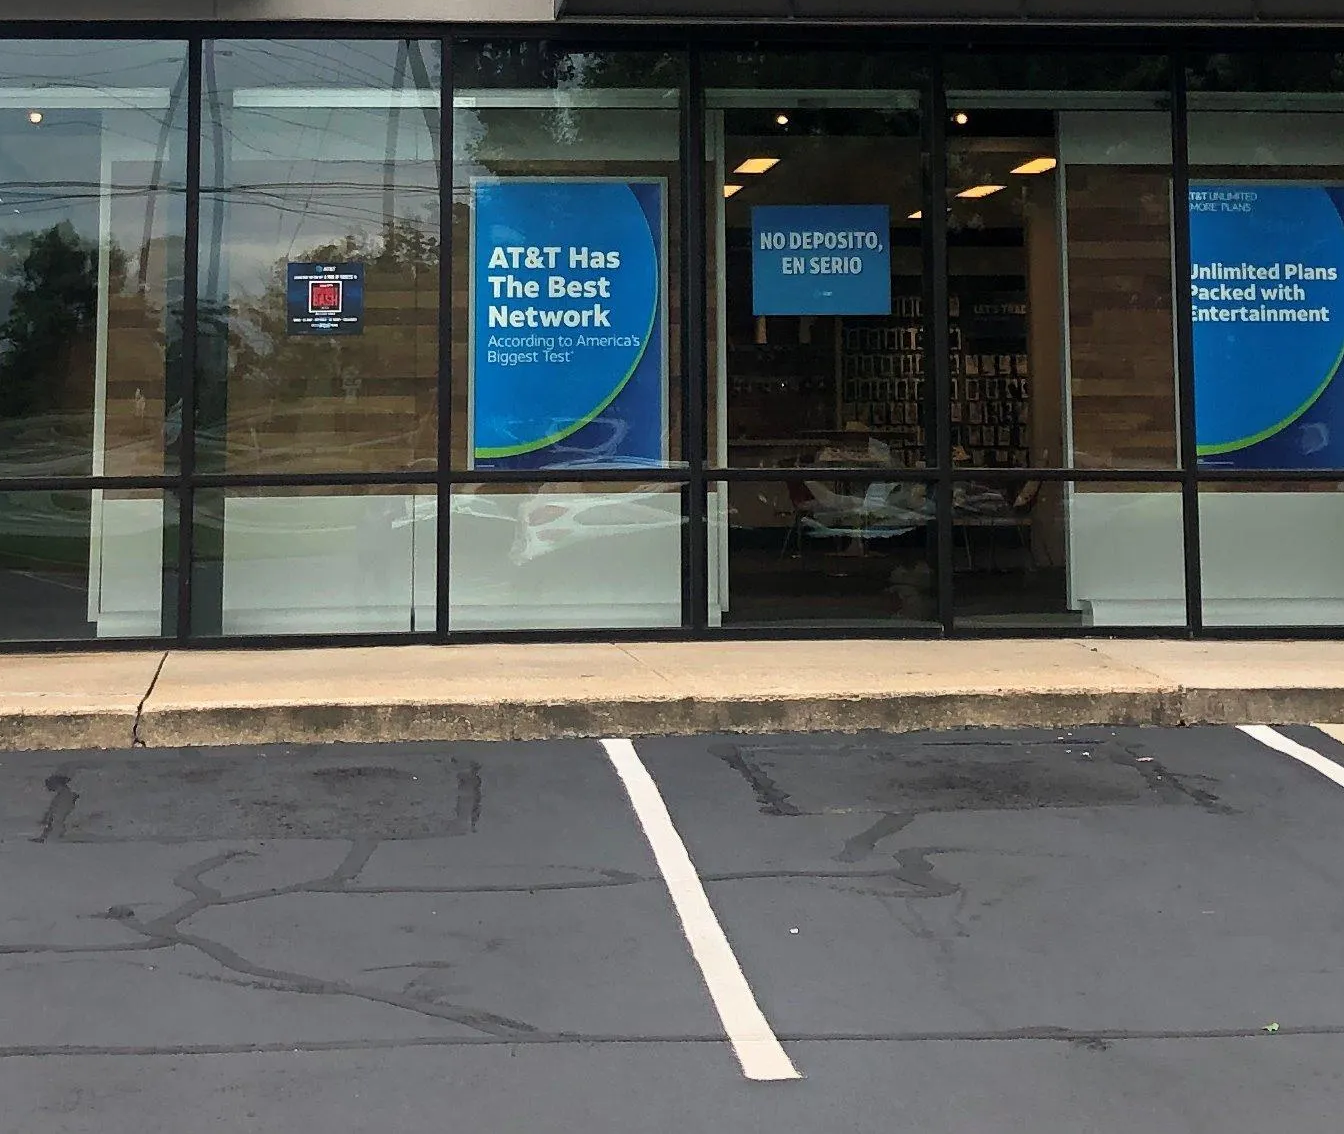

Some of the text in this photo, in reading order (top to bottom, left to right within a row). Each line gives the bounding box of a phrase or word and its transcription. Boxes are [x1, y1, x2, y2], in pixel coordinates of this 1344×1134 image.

[1209, 192, 1258, 201] UNLIMITED
[1221, 203, 1251, 212] PLANS
[760, 231, 883, 253] NO DEPOSITO,
[488, 246, 620, 269] AT&T Has
[782, 256, 863, 275] EN SERIO
[1284, 263, 1338, 281] Plans
[488, 275, 611, 298] The Best
[1261, 284, 1305, 301] with
[488, 303, 611, 328] Network
[488, 334, 640, 350] According to America's
[488, 350, 538, 366] Biggest
